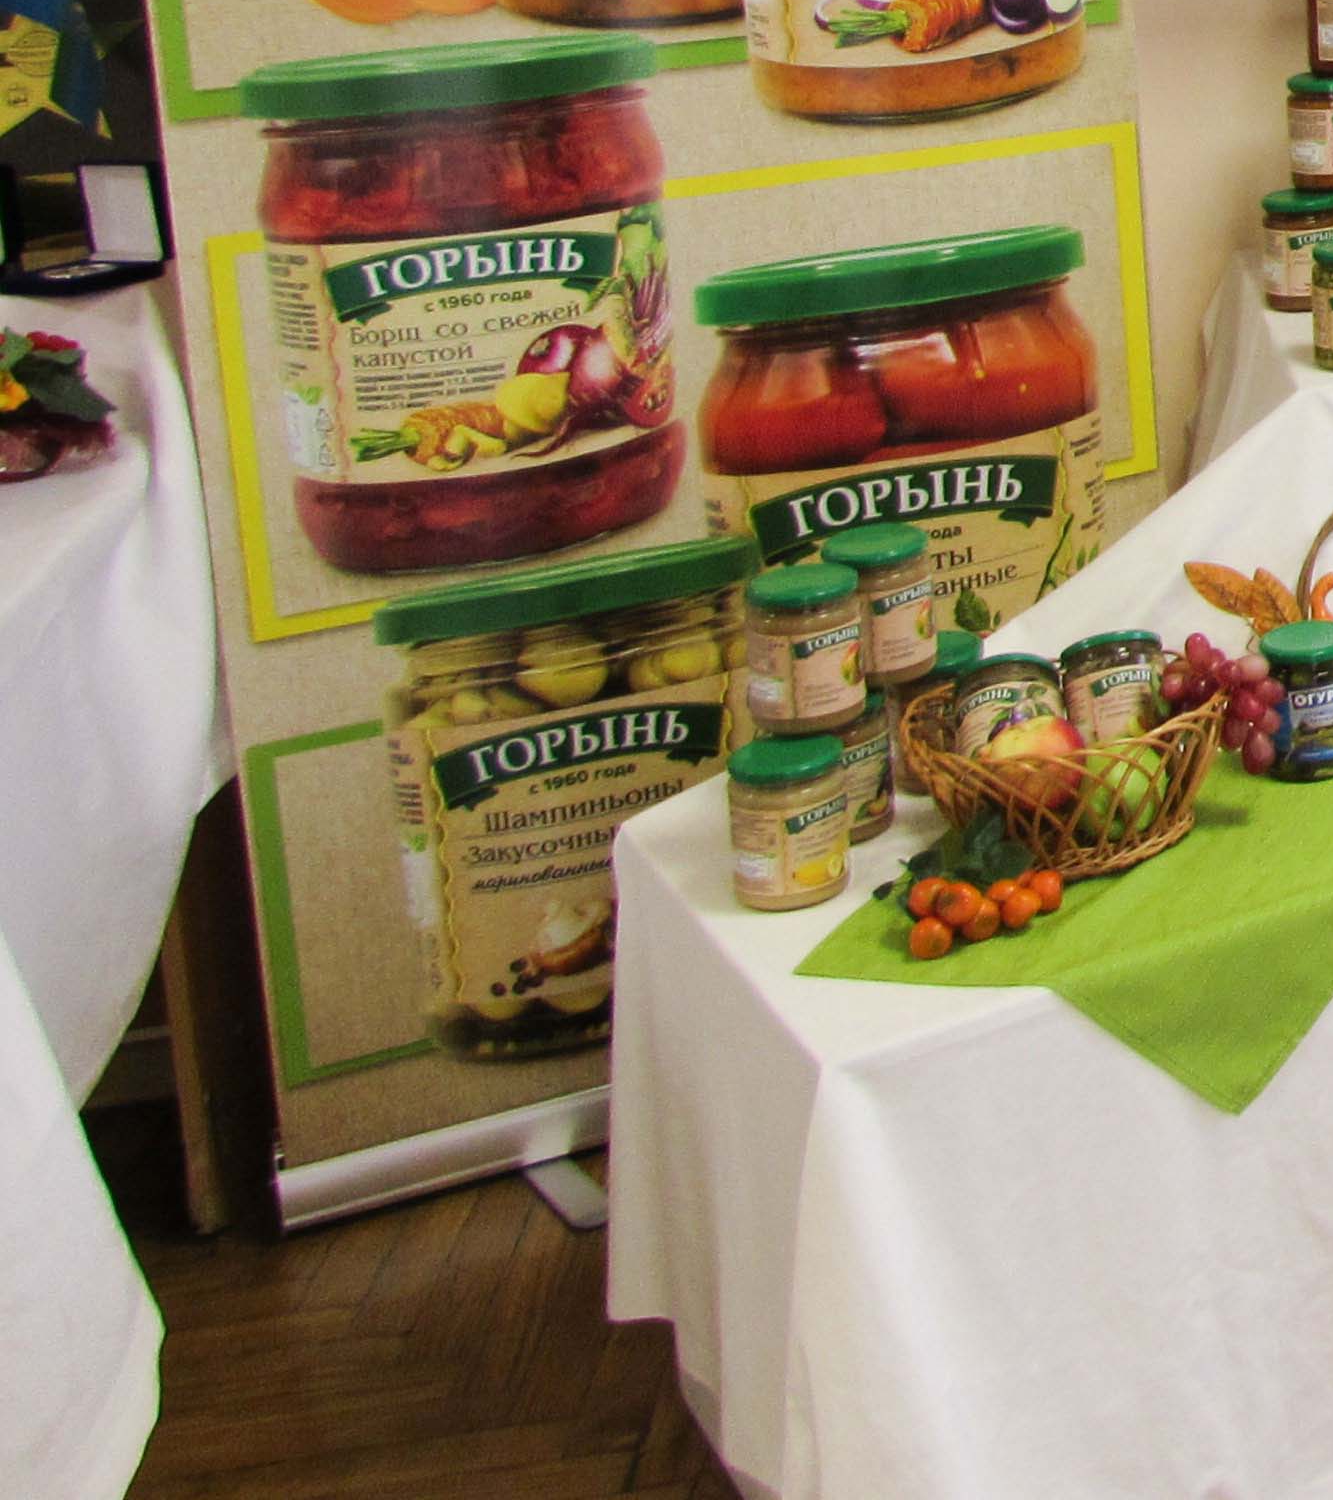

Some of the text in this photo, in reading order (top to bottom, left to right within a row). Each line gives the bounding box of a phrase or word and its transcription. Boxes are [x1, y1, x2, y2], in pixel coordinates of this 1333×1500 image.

[361, 238, 584, 297] ГОРЫНЬ
[439, 291, 485, 310] 1960
[489, 288, 533, 304] года
[350, 300, 582, 348] Борщ со свежей
[352, 341, 474, 370] капустой
[788, 463, 1023, 537] ГОРЫНЬ
[468, 710, 689, 784] ГОРЫНЬ
[544, 770, 589, 791] 1960
[594, 763, 637, 781] года
[485, 779, 685, 833] Шампиньоны
[462, 826, 617, 864] «Закусочны
